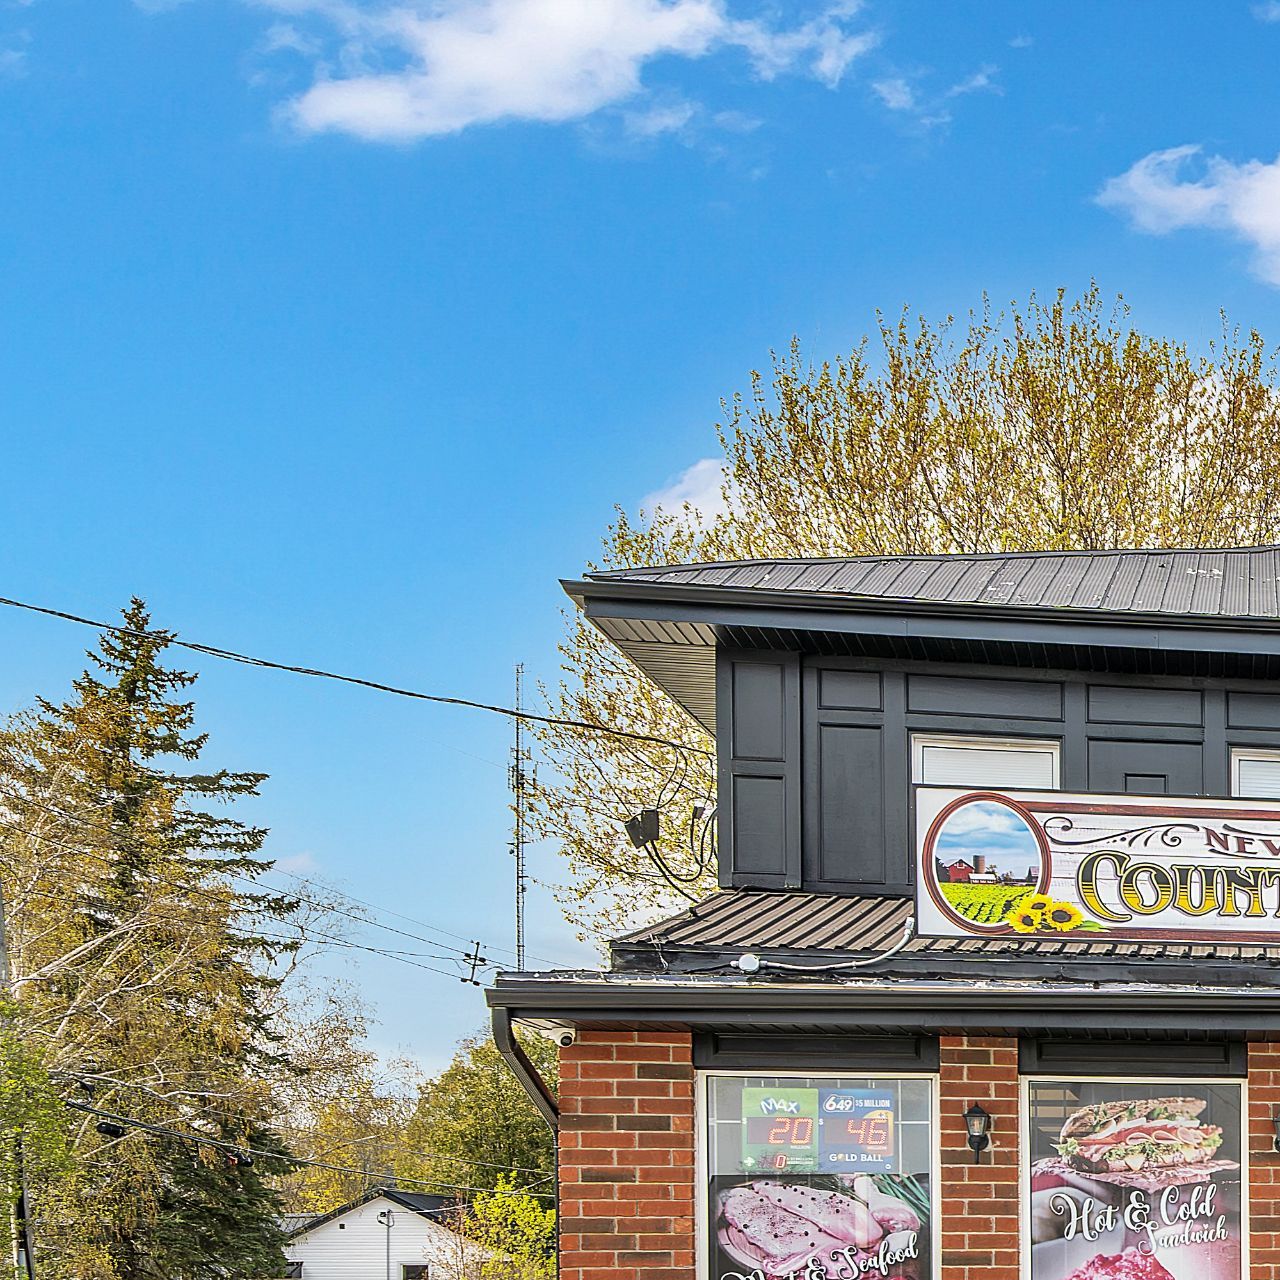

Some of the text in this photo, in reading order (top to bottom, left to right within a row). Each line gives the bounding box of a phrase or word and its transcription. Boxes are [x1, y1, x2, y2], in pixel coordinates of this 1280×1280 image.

[760, 1098, 798, 1114] MAX
[825, 1096, 853, 1111] 649
[864, 1099, 890, 1108] MILLION
[769, 1118, 813, 1145] 20
[860, 1153, 883, 1162] BALL
[1050, 1184, 1217, 1241] Hot & Cold
[1135, 1215, 1229, 1256] Sandwich
